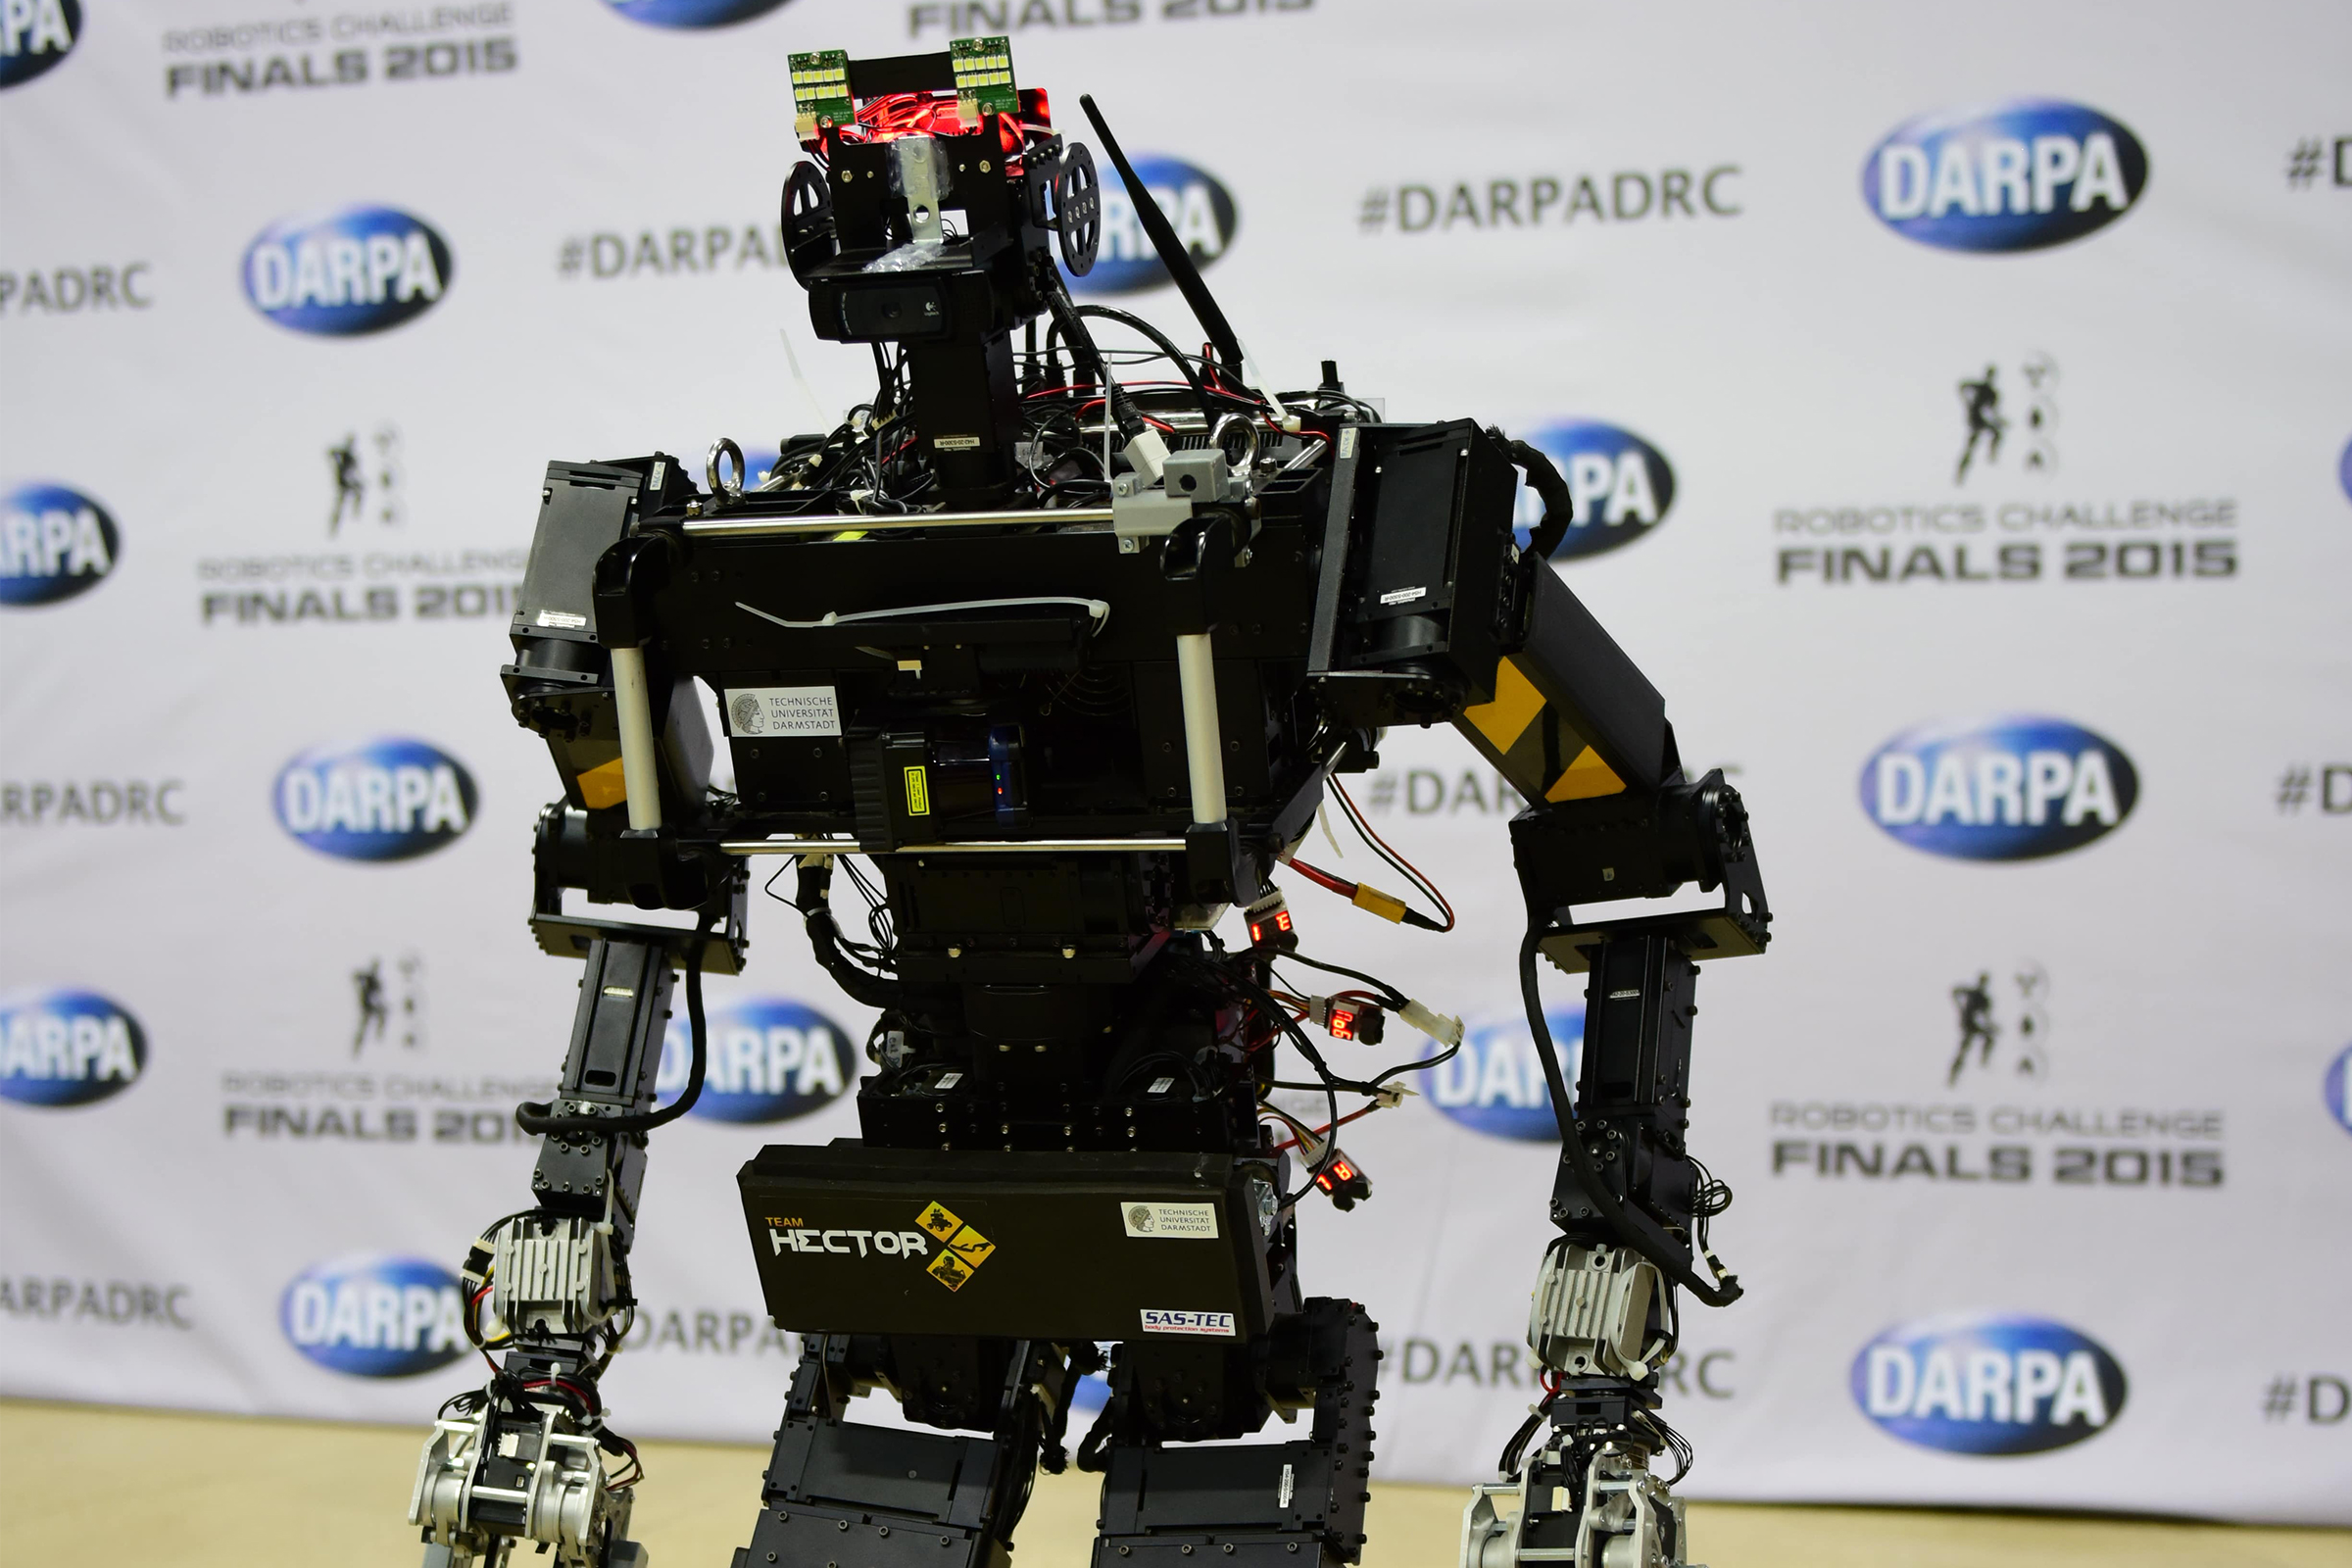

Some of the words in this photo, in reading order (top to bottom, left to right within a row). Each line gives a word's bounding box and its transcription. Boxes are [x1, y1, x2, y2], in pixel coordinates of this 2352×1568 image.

[164, 17, 321, 53] ROBOTICS
[330, 2, 513, 43] CHALLENGE
[907, 0, 1140, 38] FINALS
[167, 50, 368, 97] FINALS
[385, 37, 516, 80] 2015
[1880, 133, 2128, 220] DARPA
[1357, 165, 1743, 235] #DARPADRC
[253, 231, 443, 312] DARPA
[1774, 503, 1985, 535] ROBOTICS
[1998, 499, 2238, 530] CHALLENGE
[1777, 543, 2043, 585] FINALS
[2065, 539, 2239, 580] 2015
[200, 588, 398, 626] FINALS
[769, 697, 833, 707] TECHNISCHE
[771, 708, 834, 718] UNIVERSITÄT
[772, 720, 835, 730] DARMSTADT
[287, 764, 467, 834] DARPA
[1878, 751, 2120, 826] DARPA
[224, 1104, 416, 1142] FINALS
[1771, 1102, 1977, 1135] ROBOTICS
[1987, 1104, 2224, 1140] CHALLENGE
[1772, 1142, 2033, 1184] FINALS
[2050, 1147, 2226, 1188] 2015
[765, 1216, 804, 1227] TEAM
[769, 1229, 929, 1260] HECTOR
[295, 1282, 467, 1353] DARPA
[1145, 1311, 1232, 1328] SAS-TEC
[1867, 1349, 2107, 1430] DARPA
